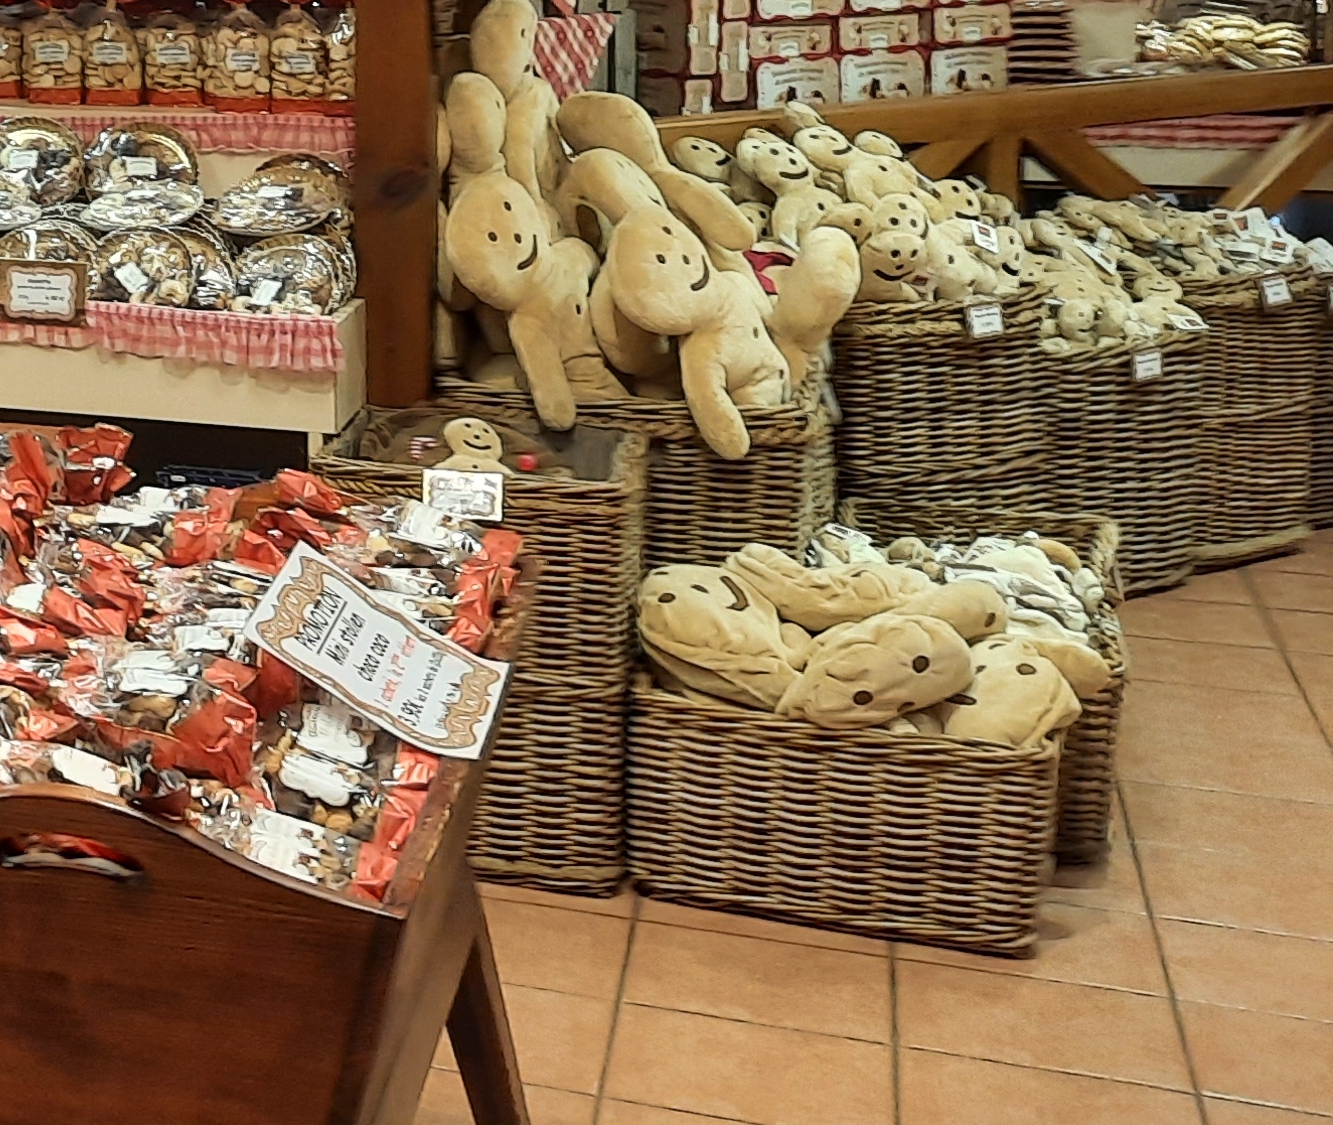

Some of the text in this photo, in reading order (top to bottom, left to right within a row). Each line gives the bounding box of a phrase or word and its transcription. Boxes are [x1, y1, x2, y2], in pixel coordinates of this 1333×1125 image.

[294, 586, 343, 651] PROMOTION
[325, 612, 366, 666] Mini stollen
[353, 633, 390, 682] choco coco
